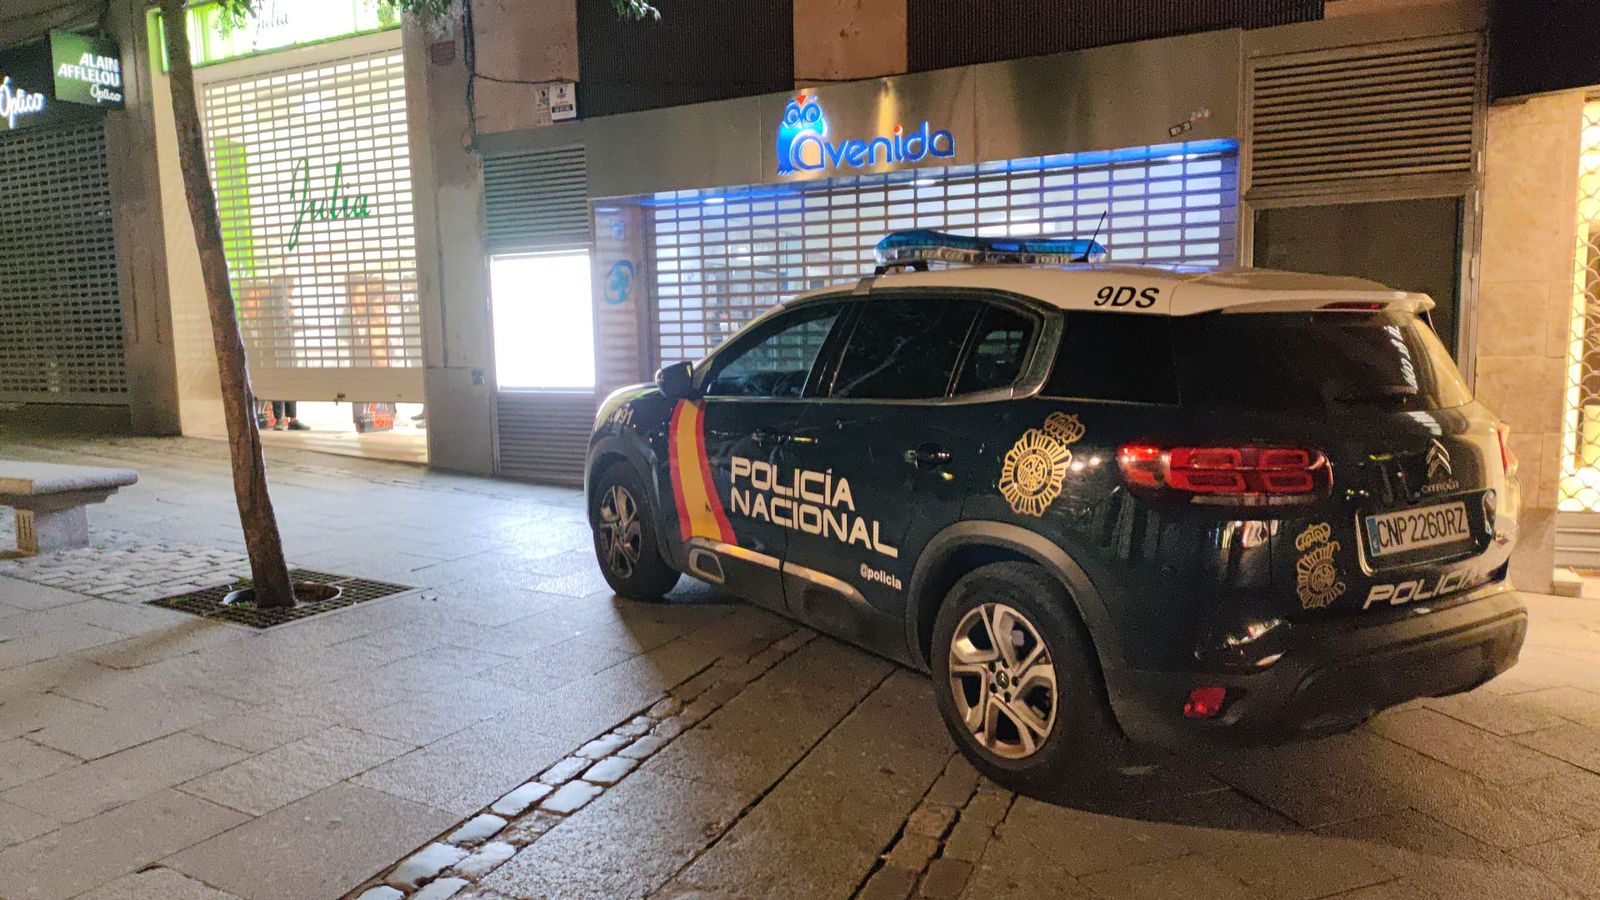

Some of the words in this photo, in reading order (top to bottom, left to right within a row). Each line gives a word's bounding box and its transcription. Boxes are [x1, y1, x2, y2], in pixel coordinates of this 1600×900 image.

[57, 62, 120, 88] AFFLELOU
[79, 52, 119, 72] ALAIN
[790, 120, 955, 171] avenida
[288, 157, 371, 252] Julia
[1094, 286, 1160, 308] 9DS
[730, 456, 856, 512] POLICÍA
[730, 486, 898, 559] NACIONAL
[860, 562, 902, 590] @policia
